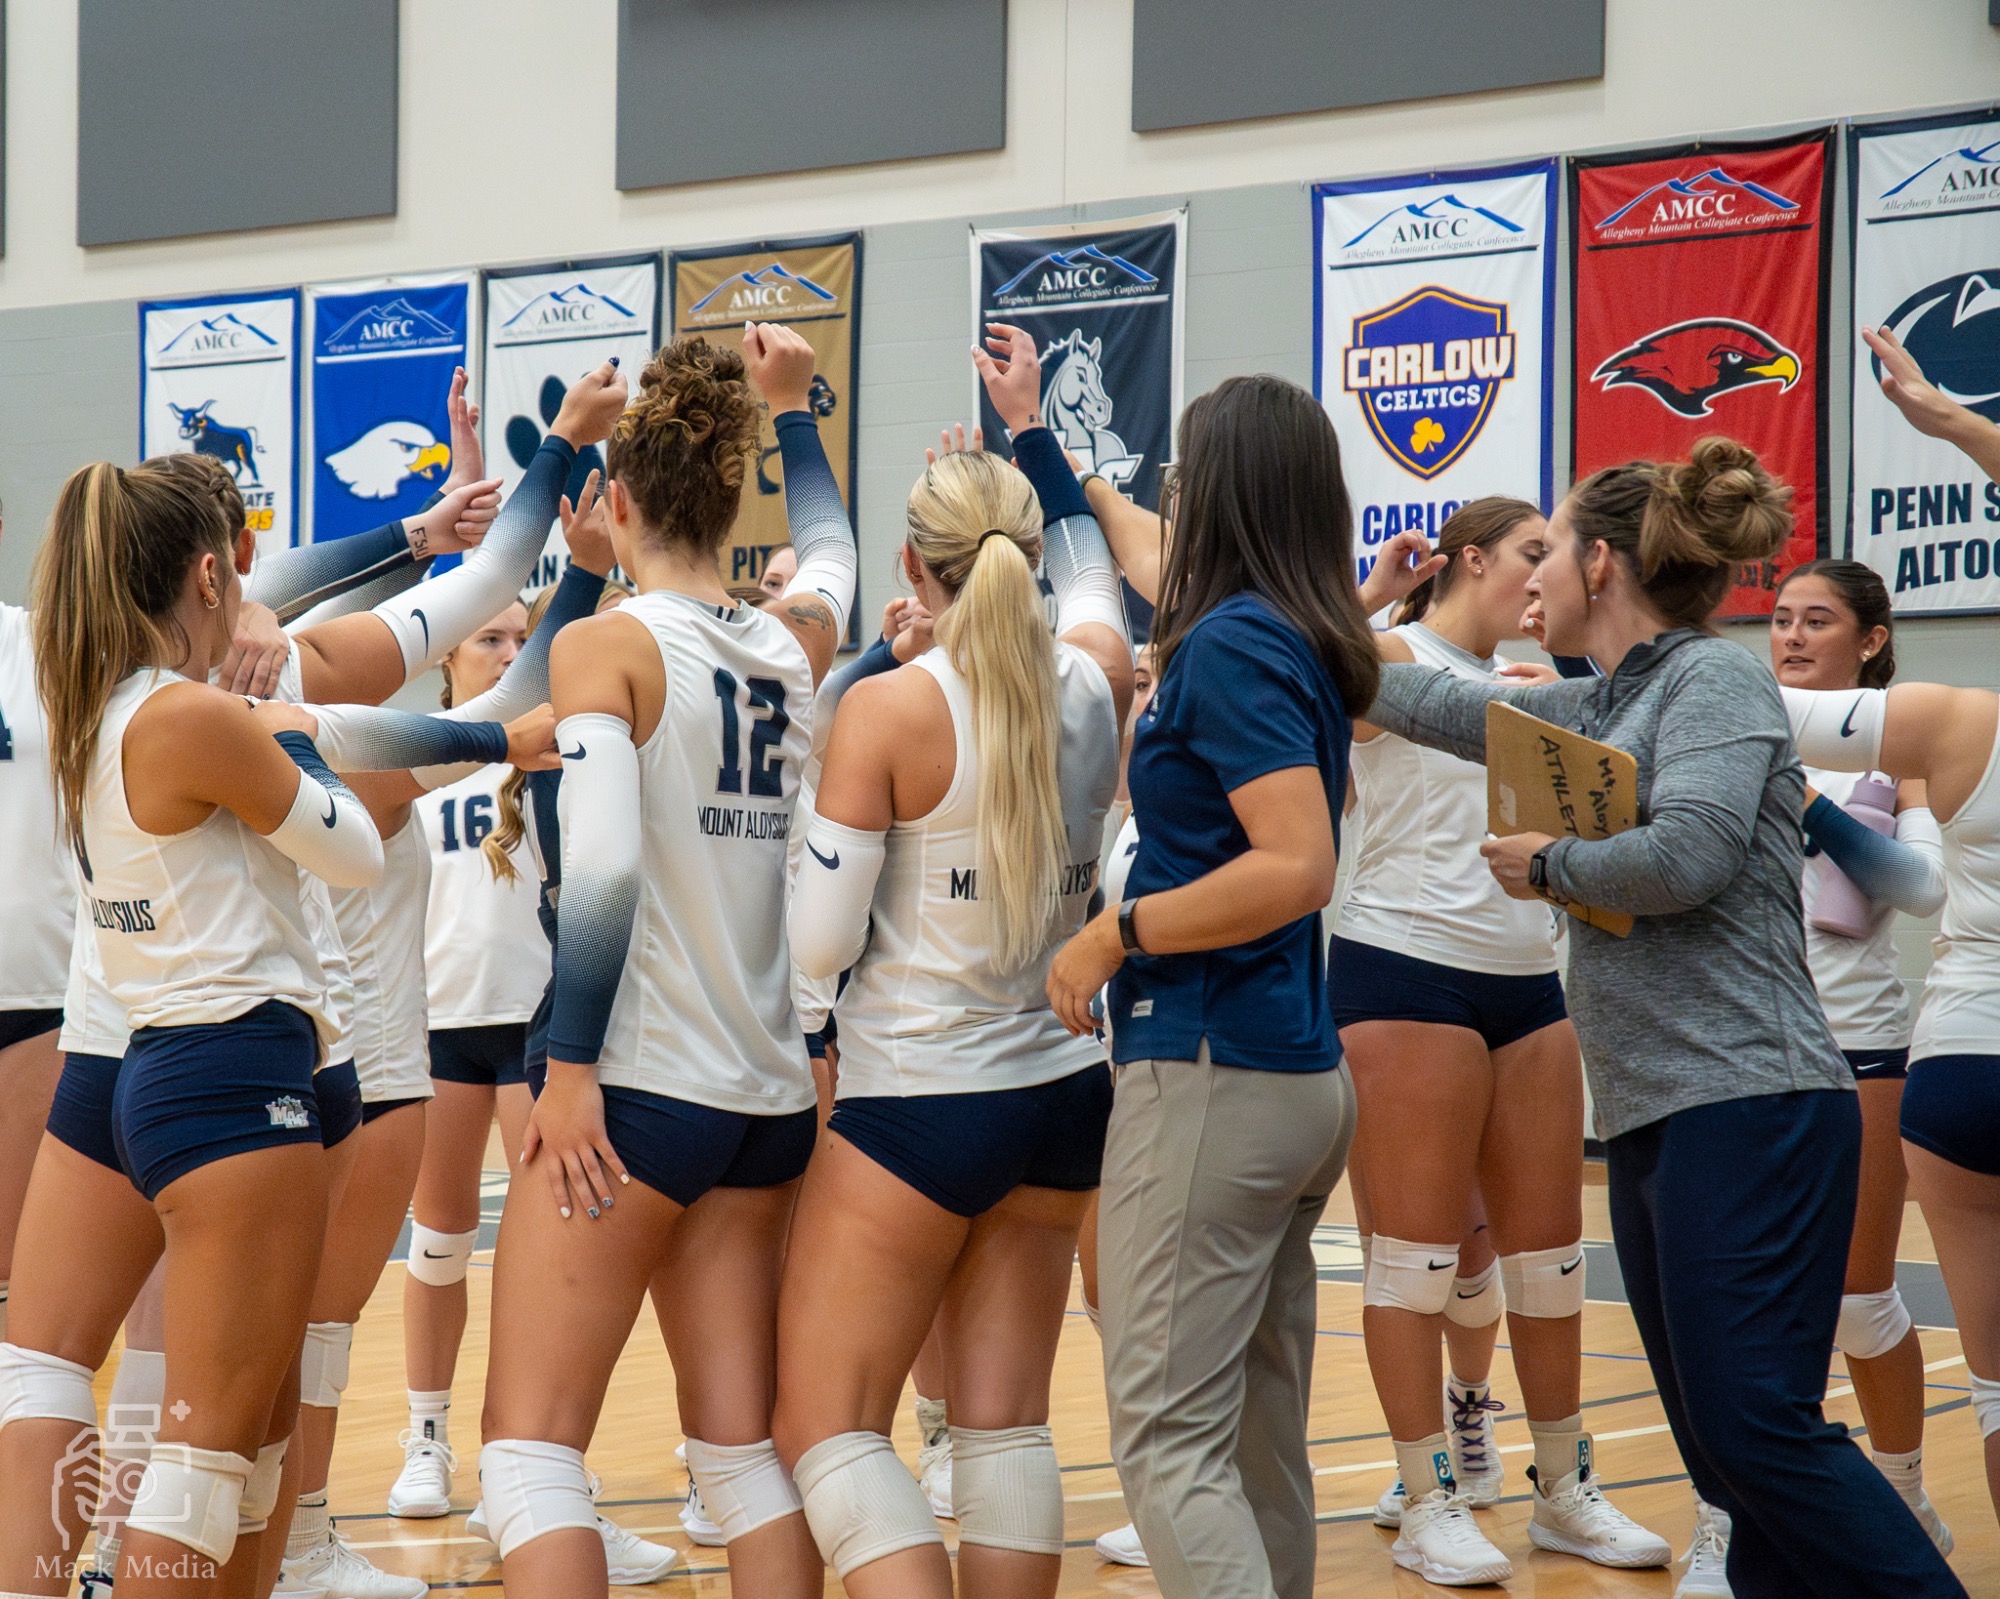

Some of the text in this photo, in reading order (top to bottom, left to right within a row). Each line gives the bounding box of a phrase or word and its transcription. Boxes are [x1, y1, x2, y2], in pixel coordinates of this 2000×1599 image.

[1652, 194, 1736, 222] AMCC
[1392, 218, 1468, 243] AMCC
[1600, 211, 1800, 240] Allegheny Mountain Collegiate Conference
[1038, 267, 1107, 291] AMCC
[1113, 282, 1157, 296] Conference
[729, 285, 792, 309] AMCC
[538, 304, 595, 325] AMCC
[191, 332, 243, 352] AMCC
[360, 320, 415, 340] AMCC
[1347, 335, 1513, 389] CARLOW
[1375, 384, 1482, 413] CELTICS
[1871, 482, 1972, 536] PENN
[410, 526, 429, 558] FSU
[733, 545, 772, 581] PIT
[1895, 538, 2000, 593] ALTO
[714, 666, 789, 799] 12
[1539, 734, 1582, 838] ATHLET
[440, 793, 493, 852] 16
[697, 806, 788, 840] MOUNT ALOYSIUS
[1588, 789, 1610, 836] Aloy
